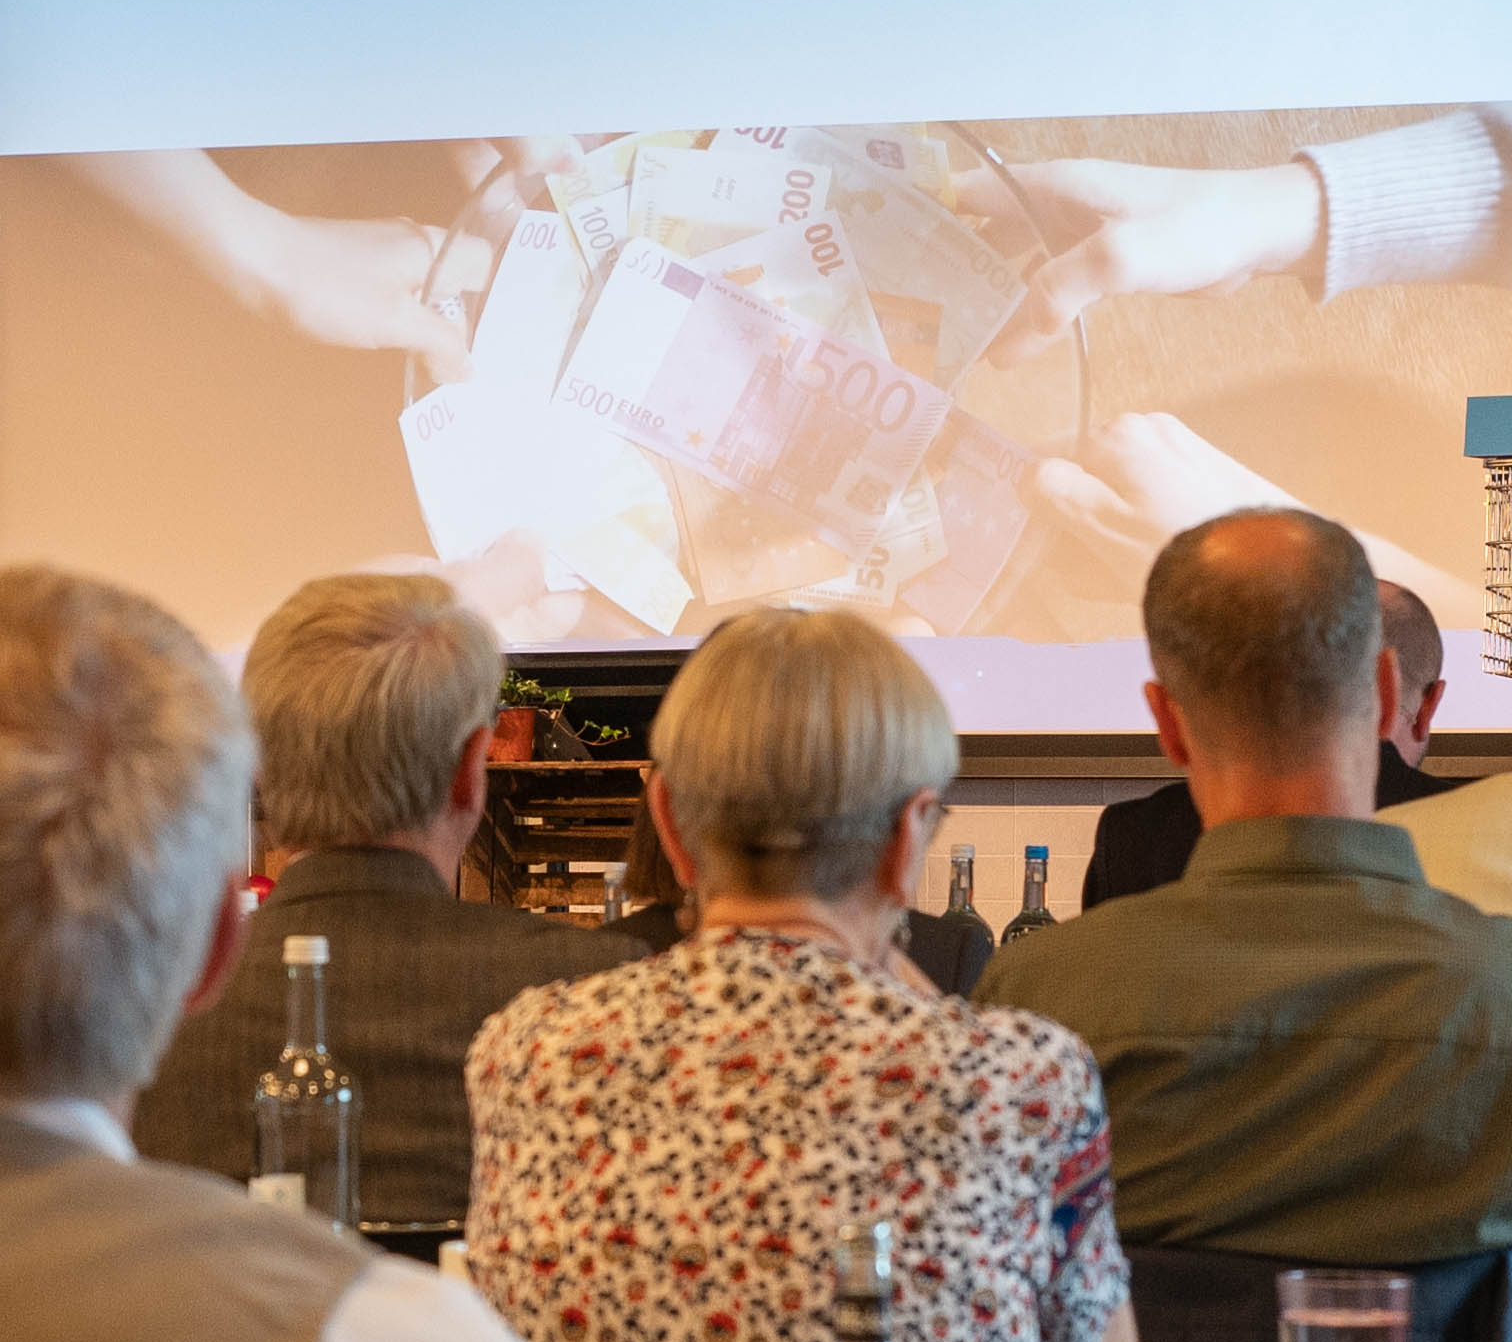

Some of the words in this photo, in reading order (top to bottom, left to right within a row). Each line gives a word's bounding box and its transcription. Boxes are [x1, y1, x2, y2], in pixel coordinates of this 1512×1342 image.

[578, 205, 615, 249] 100
[804, 221, 845, 277] 100
[562, 376, 614, 416] 500
[616, 398, 666, 429] EURO
[802, 332, 916, 434] 500
